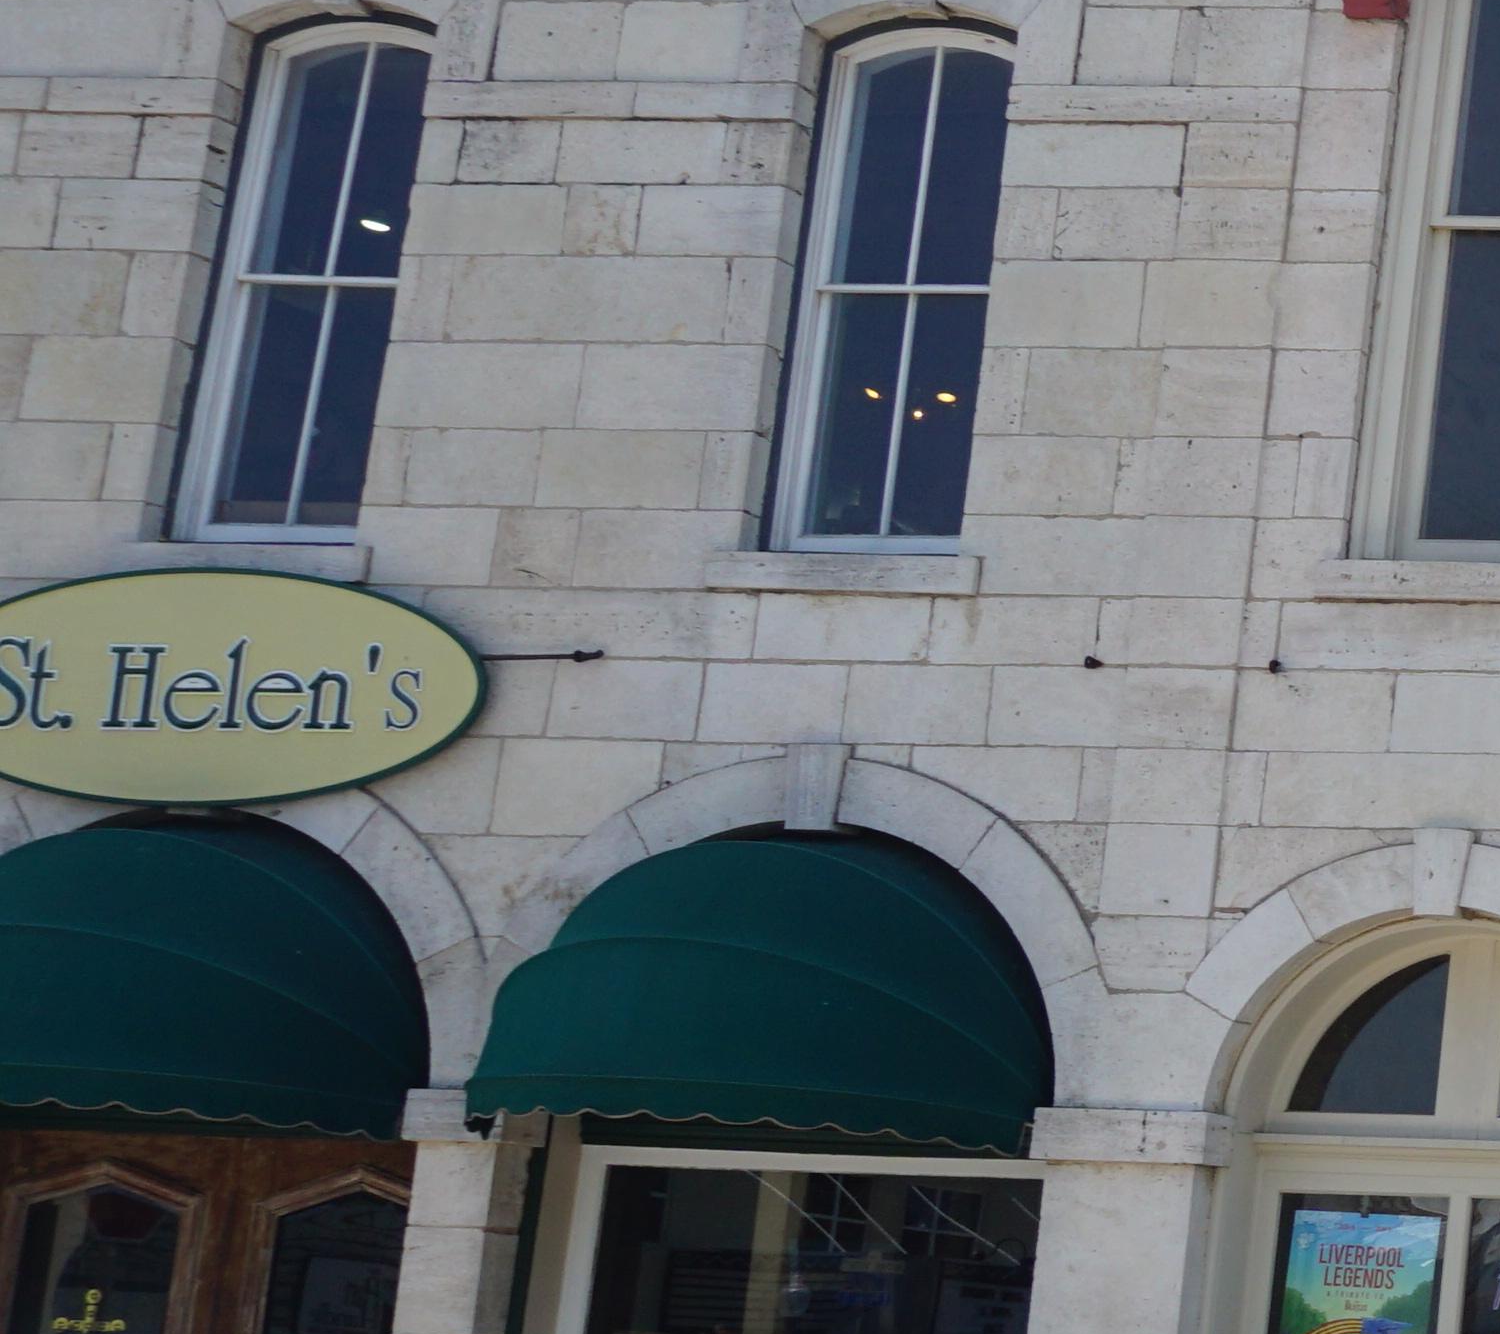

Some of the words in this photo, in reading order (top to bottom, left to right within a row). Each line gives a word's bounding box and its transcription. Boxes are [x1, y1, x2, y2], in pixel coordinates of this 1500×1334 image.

[100, 636, 424, 732] Helen's
[1318, 1243, 1405, 1268] LIVERPOOL
[1323, 1267, 1397, 1290] LEGENDS
